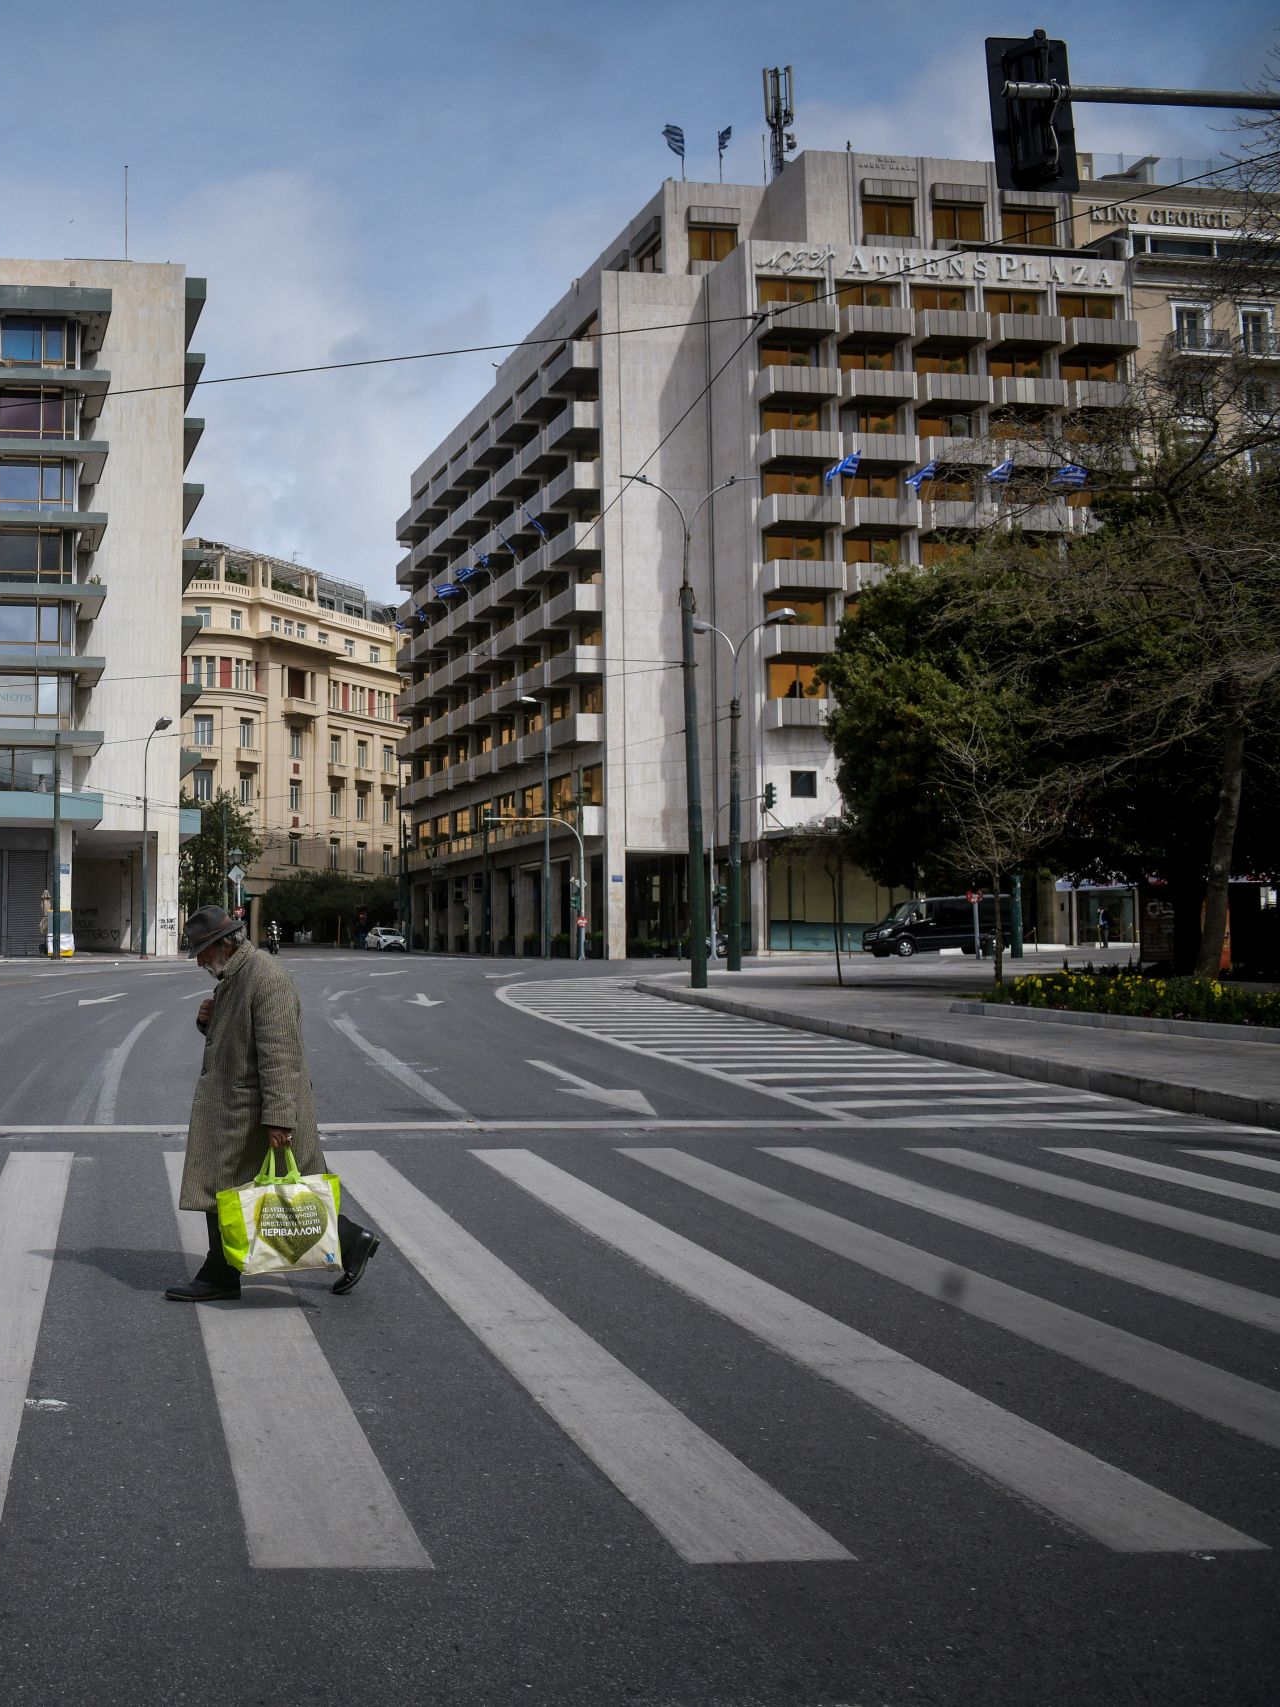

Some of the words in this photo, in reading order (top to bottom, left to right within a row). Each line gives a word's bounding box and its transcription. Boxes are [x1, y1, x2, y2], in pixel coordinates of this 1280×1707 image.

[1090, 206, 1140, 224] KING
[1149, 209, 1232, 230] GEORGE
[845, 249, 988, 280] ATHENS
[996, 255, 1114, 288] PLAZA
[260, 1226, 322, 1237] ΠΕΡΙΒΑΛΛΟΝ!
